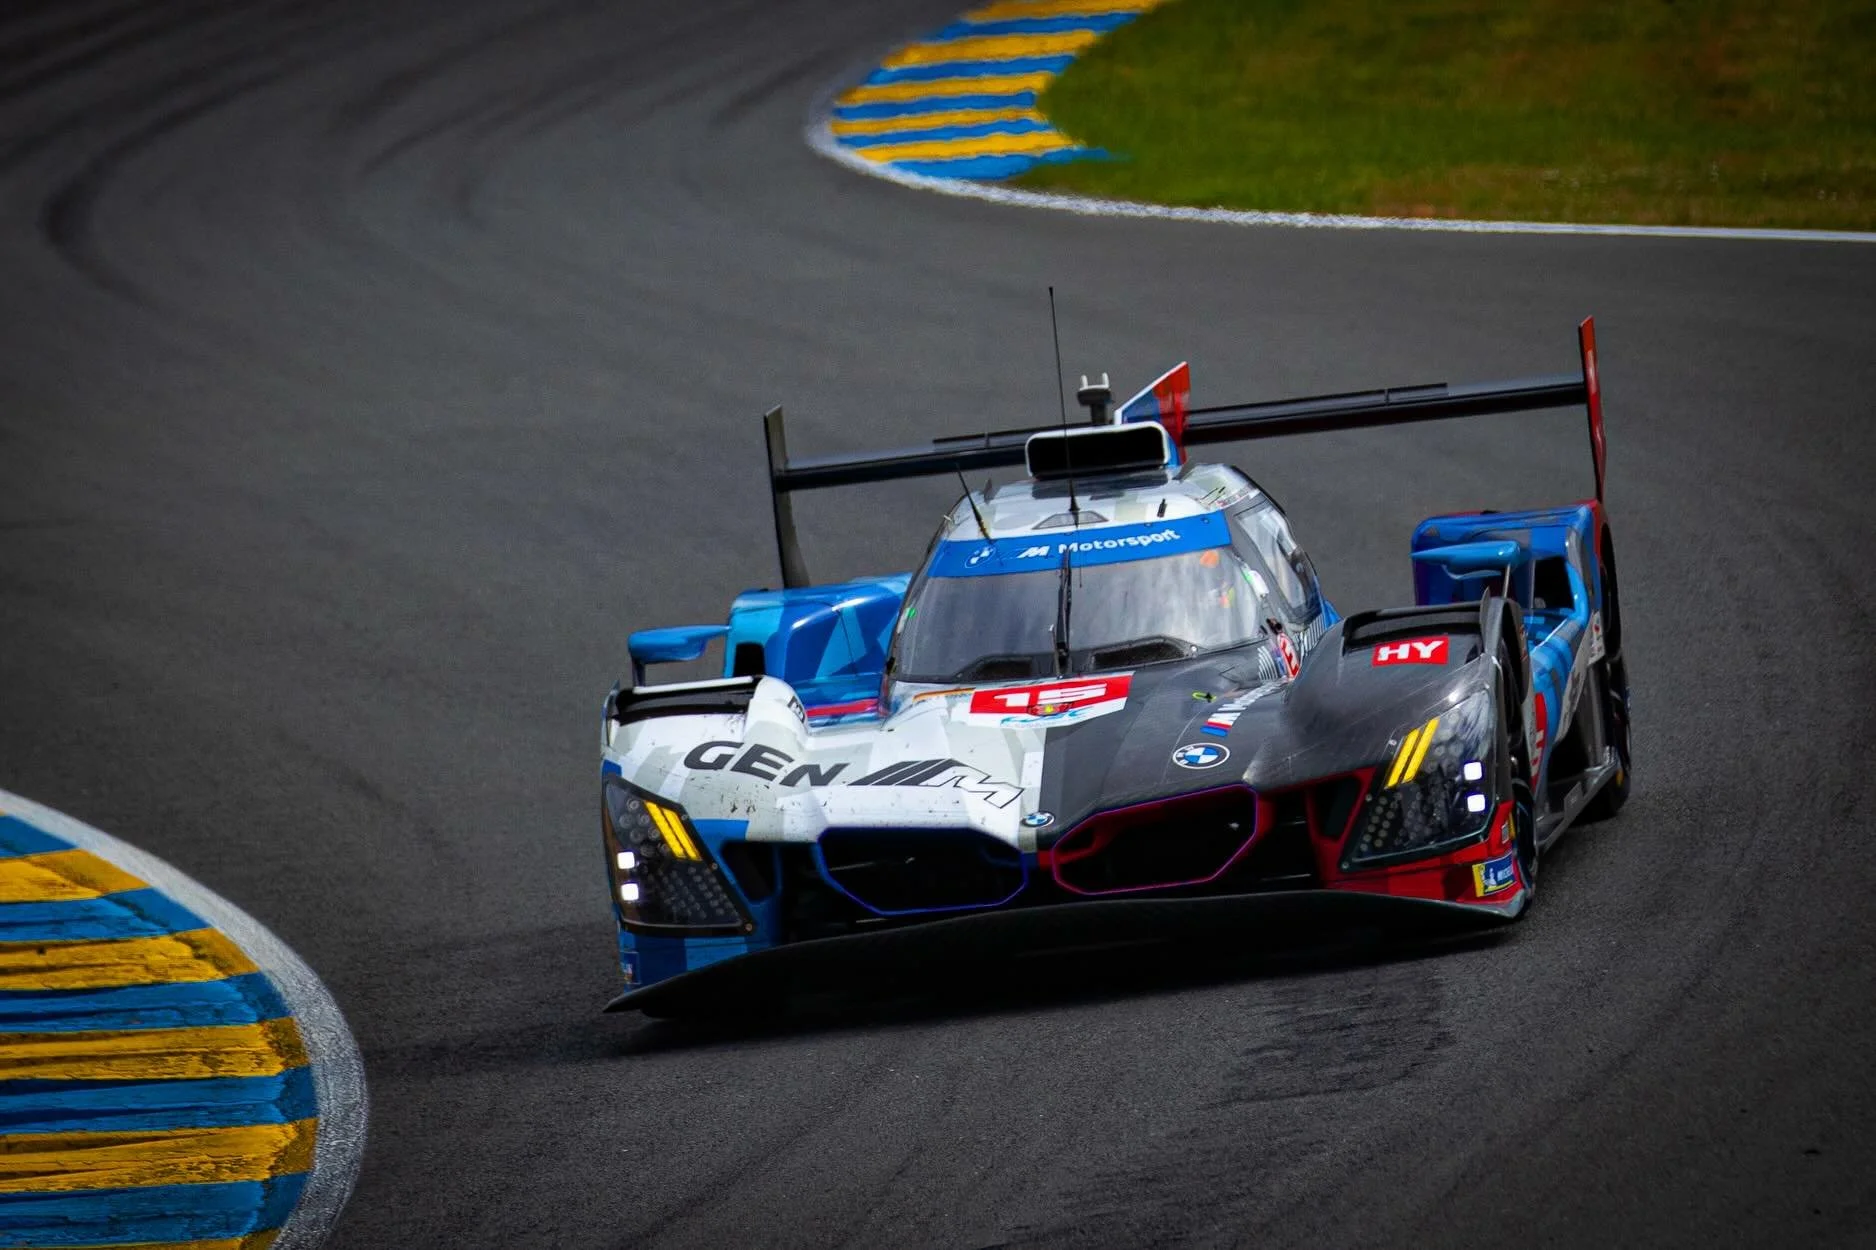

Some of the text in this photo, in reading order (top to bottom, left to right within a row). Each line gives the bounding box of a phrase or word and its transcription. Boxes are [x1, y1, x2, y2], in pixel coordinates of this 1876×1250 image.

[1058, 528, 1180, 553] Motorsport
[1377, 640, 1444, 661] HY
[993, 683, 1108, 707] 15
[683, 740, 850, 786] GEN
